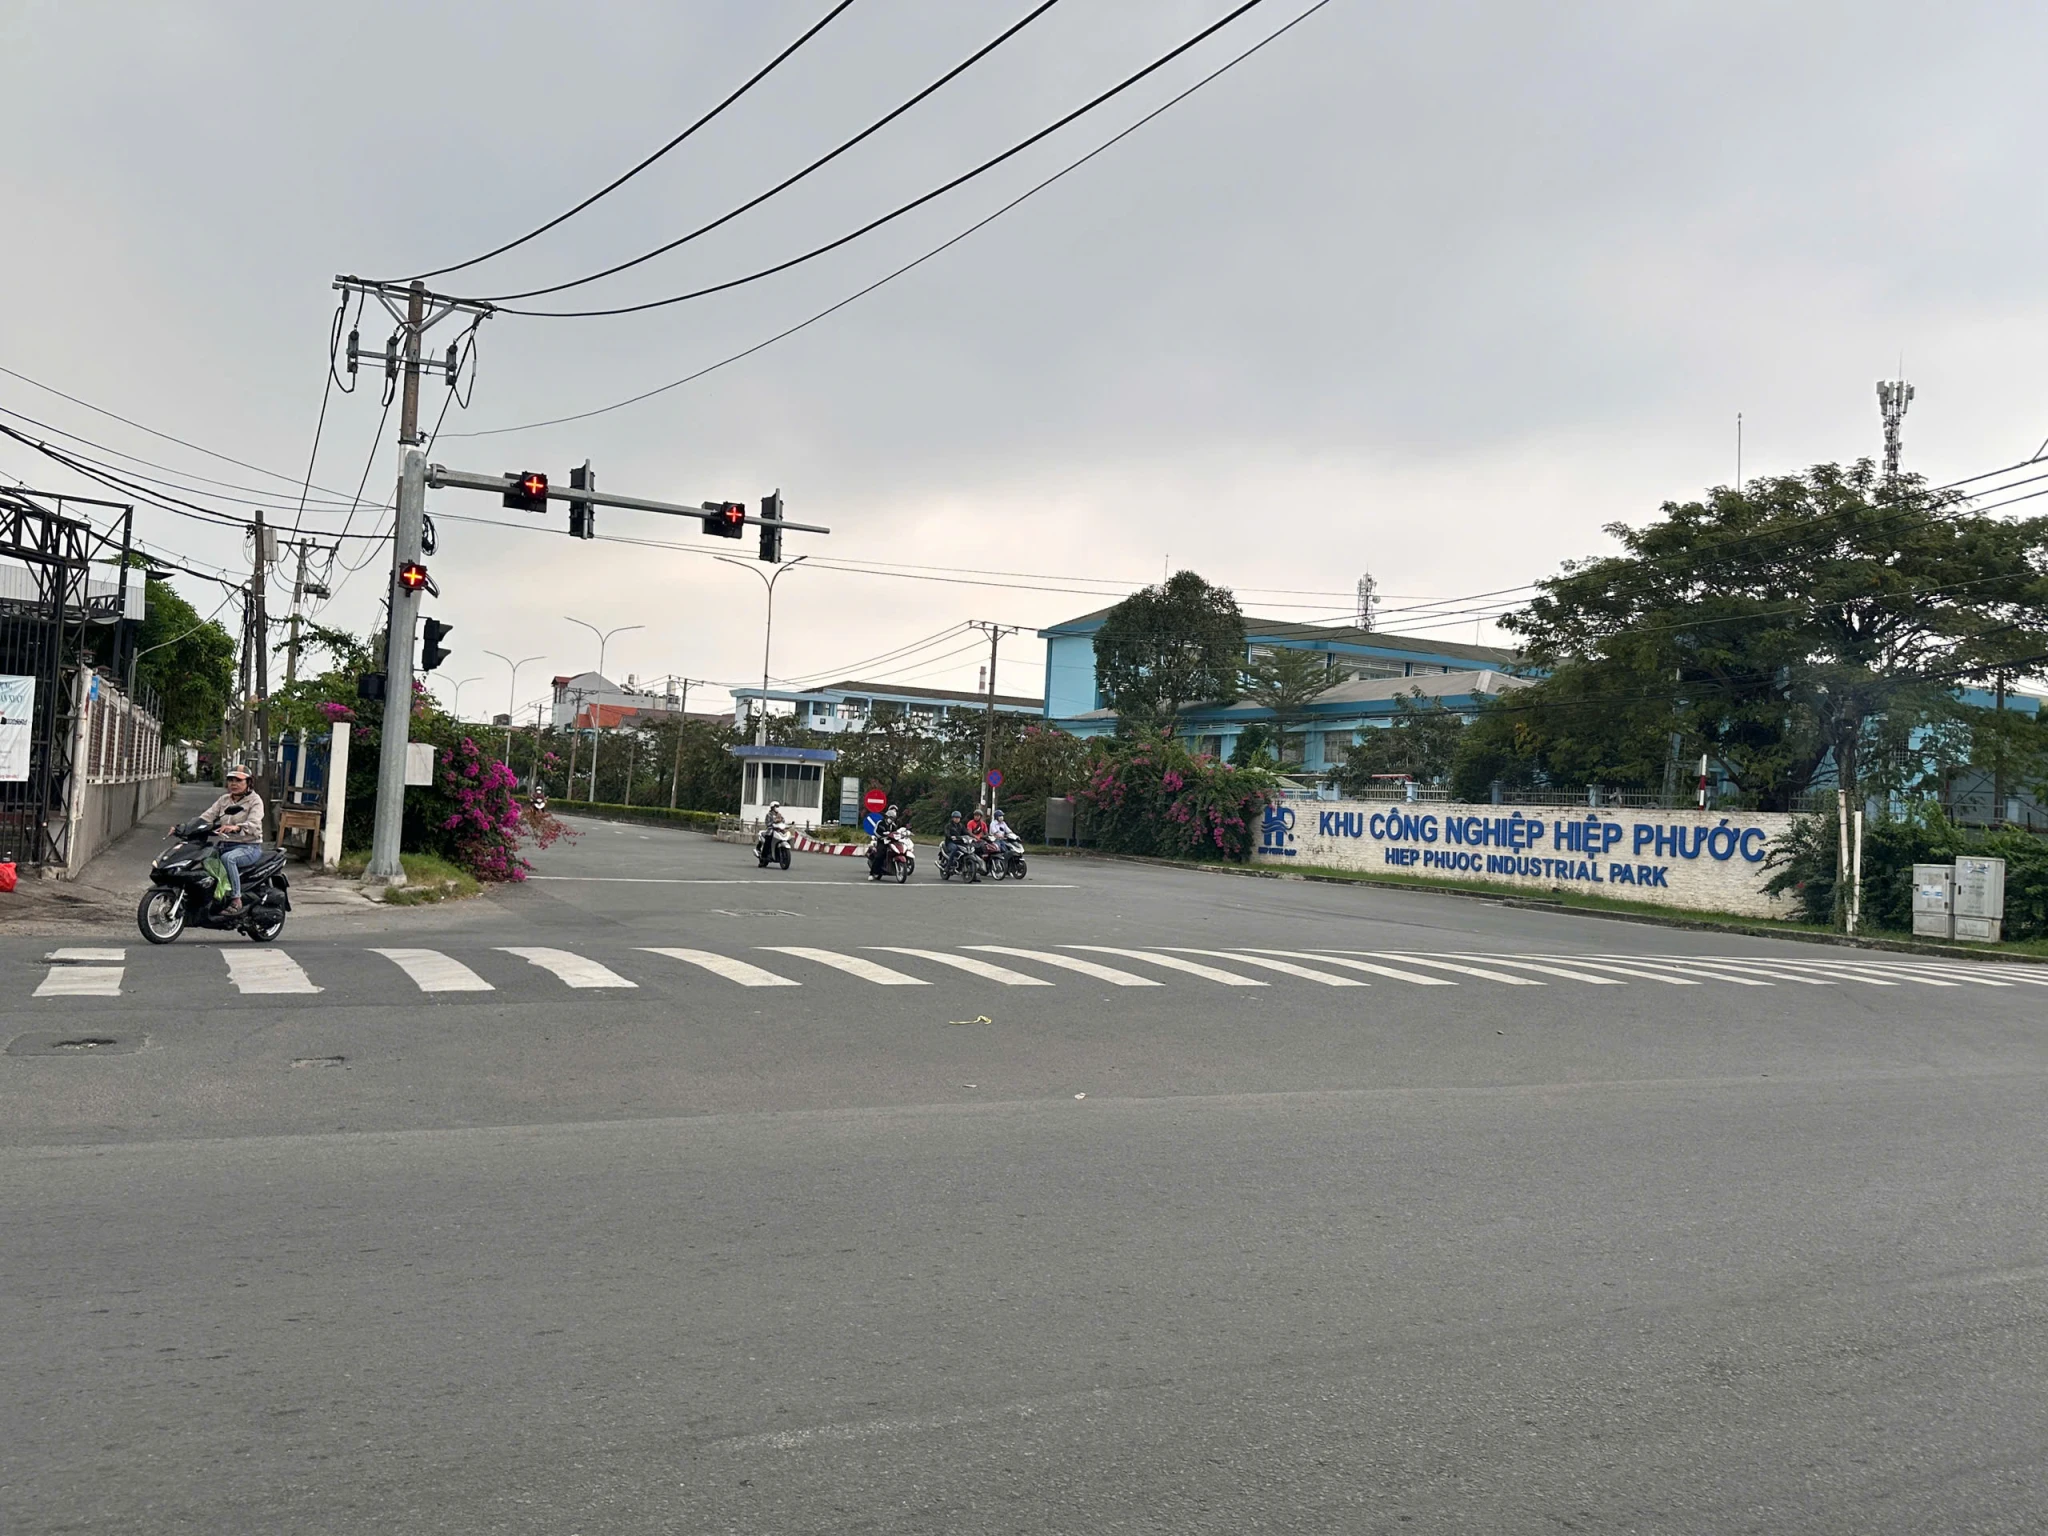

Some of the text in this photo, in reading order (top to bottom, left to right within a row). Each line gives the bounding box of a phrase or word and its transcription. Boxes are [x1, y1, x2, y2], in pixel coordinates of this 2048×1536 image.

[1319, 807, 1767, 863] KHU CÔNG NGHIỆP HIỆP PHƯỚC
[1384, 847, 1668, 888] HIEP PHUOC INDUSTRIAL PARK
